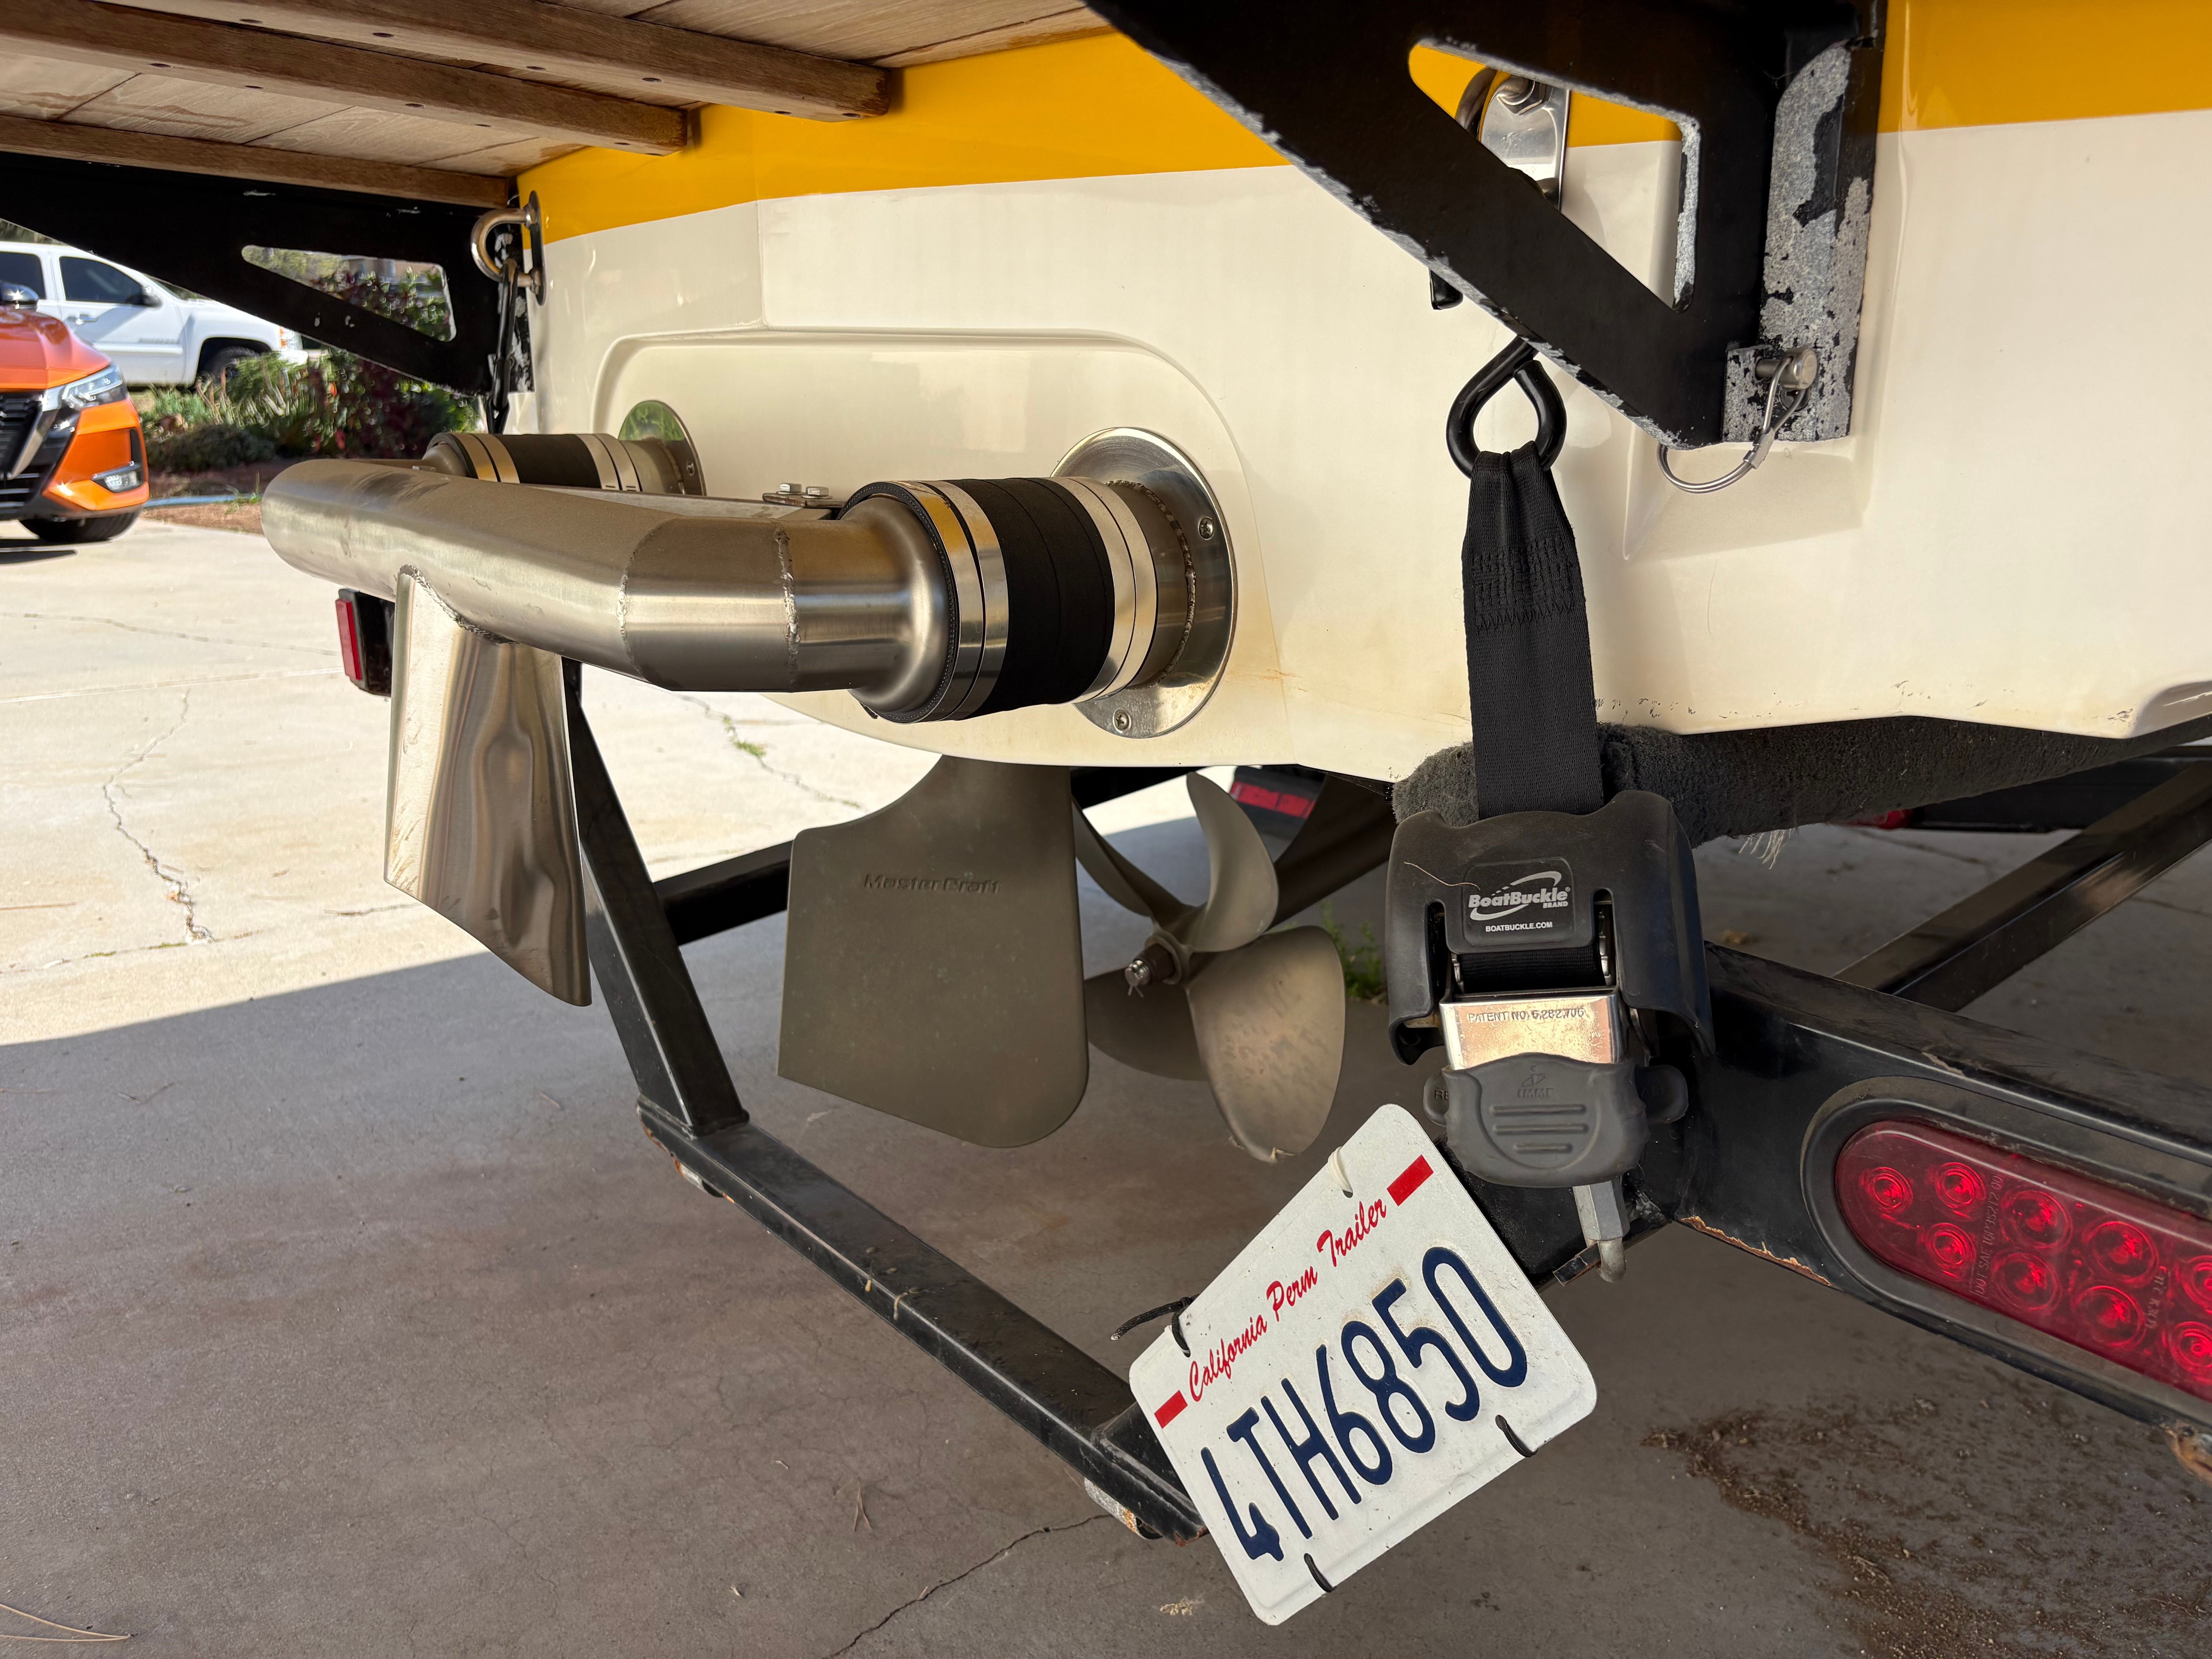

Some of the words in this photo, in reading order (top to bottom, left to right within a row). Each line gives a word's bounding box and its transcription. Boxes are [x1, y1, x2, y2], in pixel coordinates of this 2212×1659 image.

[1485, 921, 1553, 932] BOATBUCKLE.COM
[1468, 1012, 1509, 1023] PATENT
[1189, 1315, 1267, 1402] California
[1266, 1267, 1318, 1321] Perm
[1317, 1199, 1387, 1267] Trailer
[1200, 1246, 1527, 1561] 4TH6850
